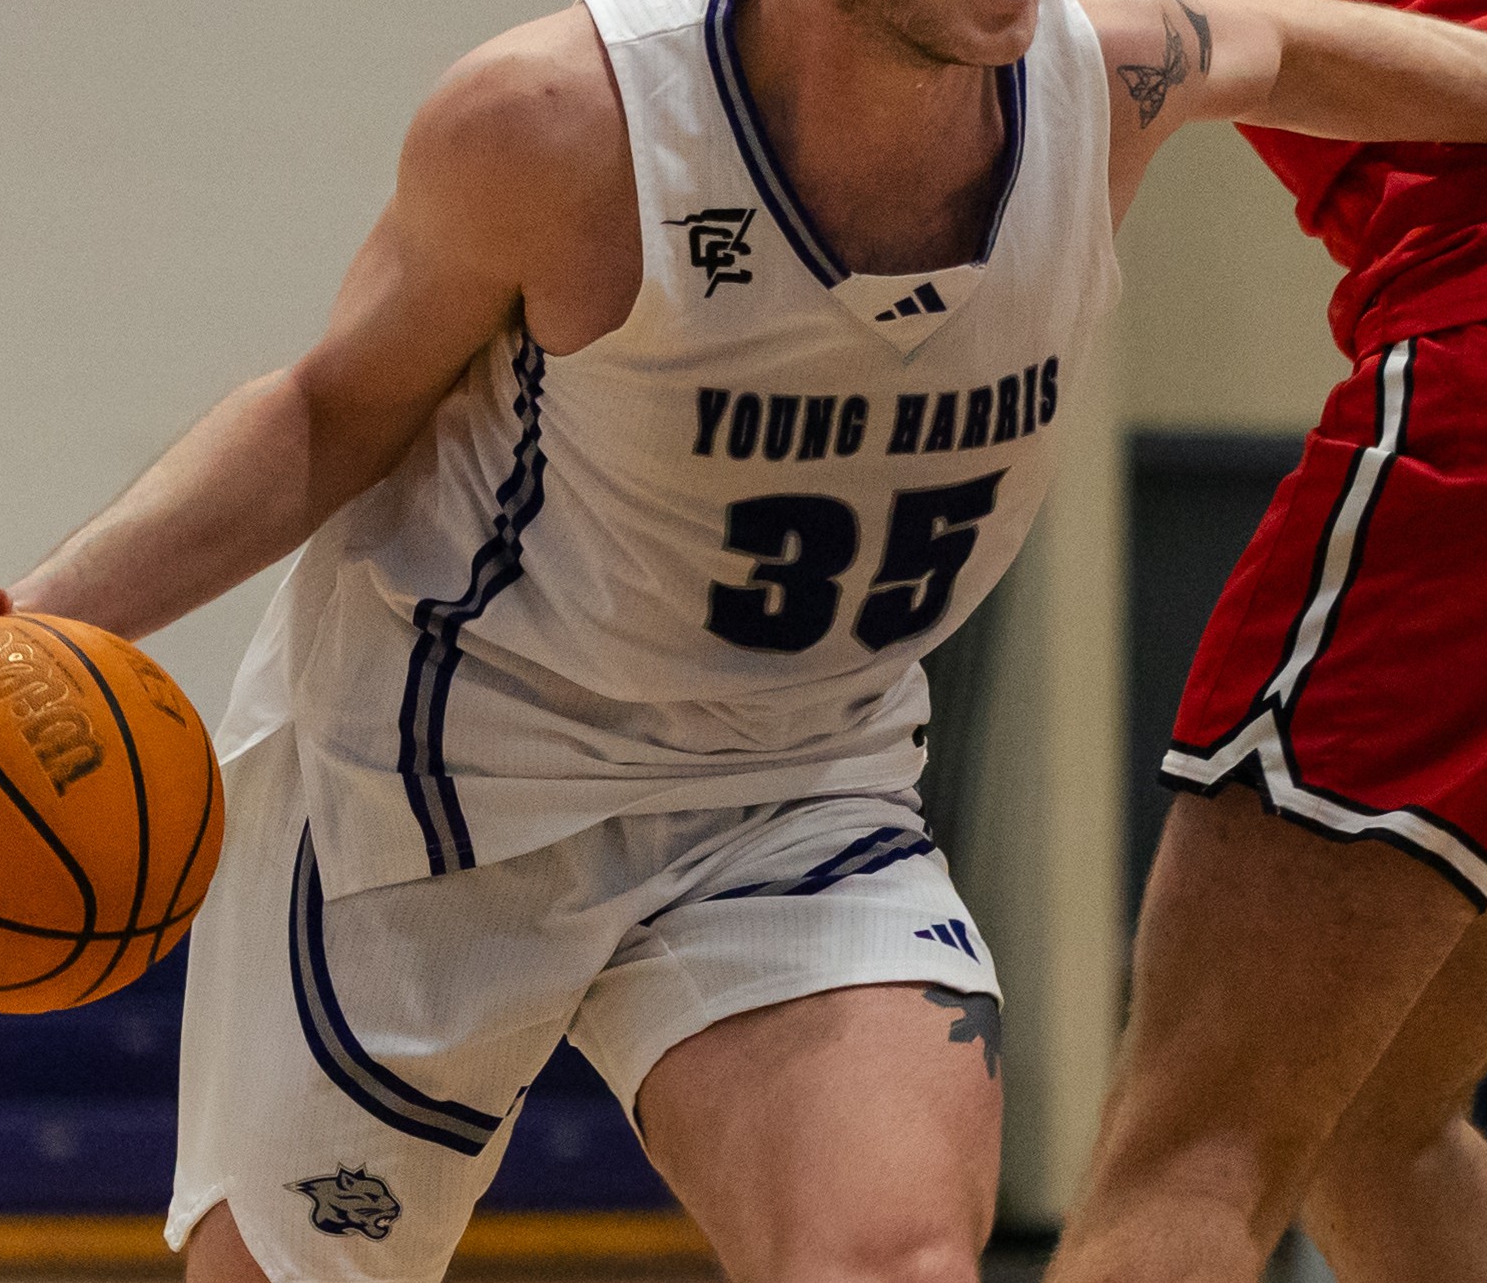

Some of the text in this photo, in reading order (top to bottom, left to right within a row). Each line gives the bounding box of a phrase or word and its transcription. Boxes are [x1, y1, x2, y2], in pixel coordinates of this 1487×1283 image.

[692, 353, 1061, 463] YOUNG HARRIS
[701, 464, 1013, 656] 35
